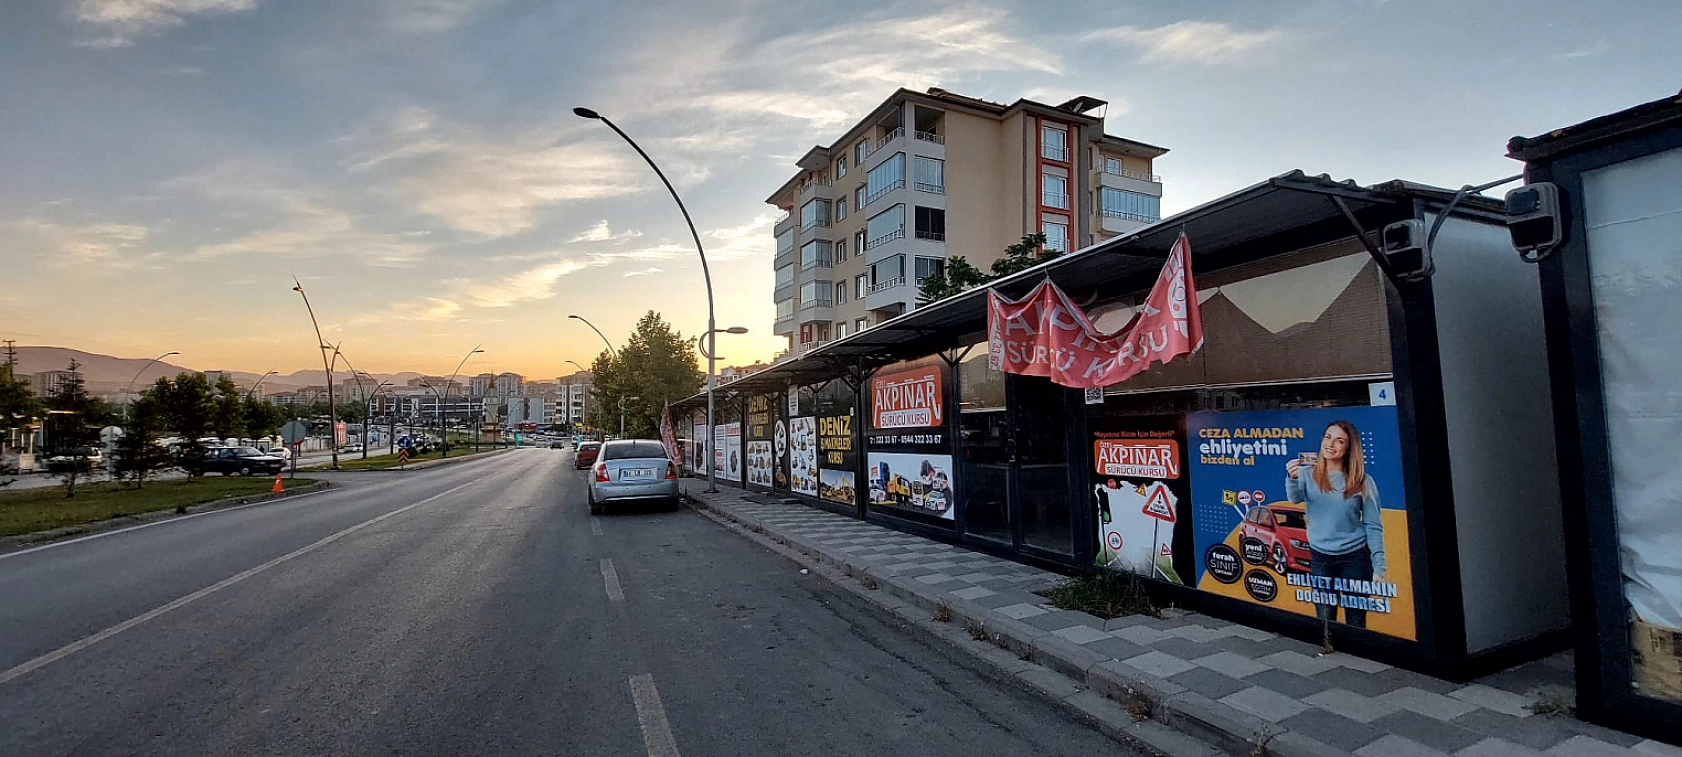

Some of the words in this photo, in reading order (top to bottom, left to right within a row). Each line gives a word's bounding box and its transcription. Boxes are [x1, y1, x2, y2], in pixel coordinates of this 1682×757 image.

[1082, 325, 1168, 378] KRSU
[1379, 389, 1387, 400] 4
[873, 381, 941, 428] AKPINAR
[907, 412, 930, 425] KURSU
[820, 415, 851, 436] DENİZ
[926, 435, 934, 444] 33
[934, 434, 942, 444] 67
[1199, 428, 1231, 438] CEZA
[1234, 427, 1304, 438] ALMADAN
[1200, 439, 1287, 458] ehliyetini
[1097, 447, 1178, 475] AKPINAR
[1201, 454, 1240, 465] bizden
[1243, 456, 1255, 466] al
[1106, 466, 1137, 475] SÜRÜCÜ
[1139, 467, 1165, 476] KURSU
[1245, 544, 1263, 552] yeni
[1212, 552, 1235, 562] ferah
[1210, 558, 1238, 571] SINIF
[1248, 576, 1273, 587] UZMAN
[1287, 572, 1332, 589] EHLİYET
[1334, 578, 1398, 597] ALMANIN
[1296, 588, 1338, 606] DOĞRU
[1340, 594, 1391, 613] ADRESİ
